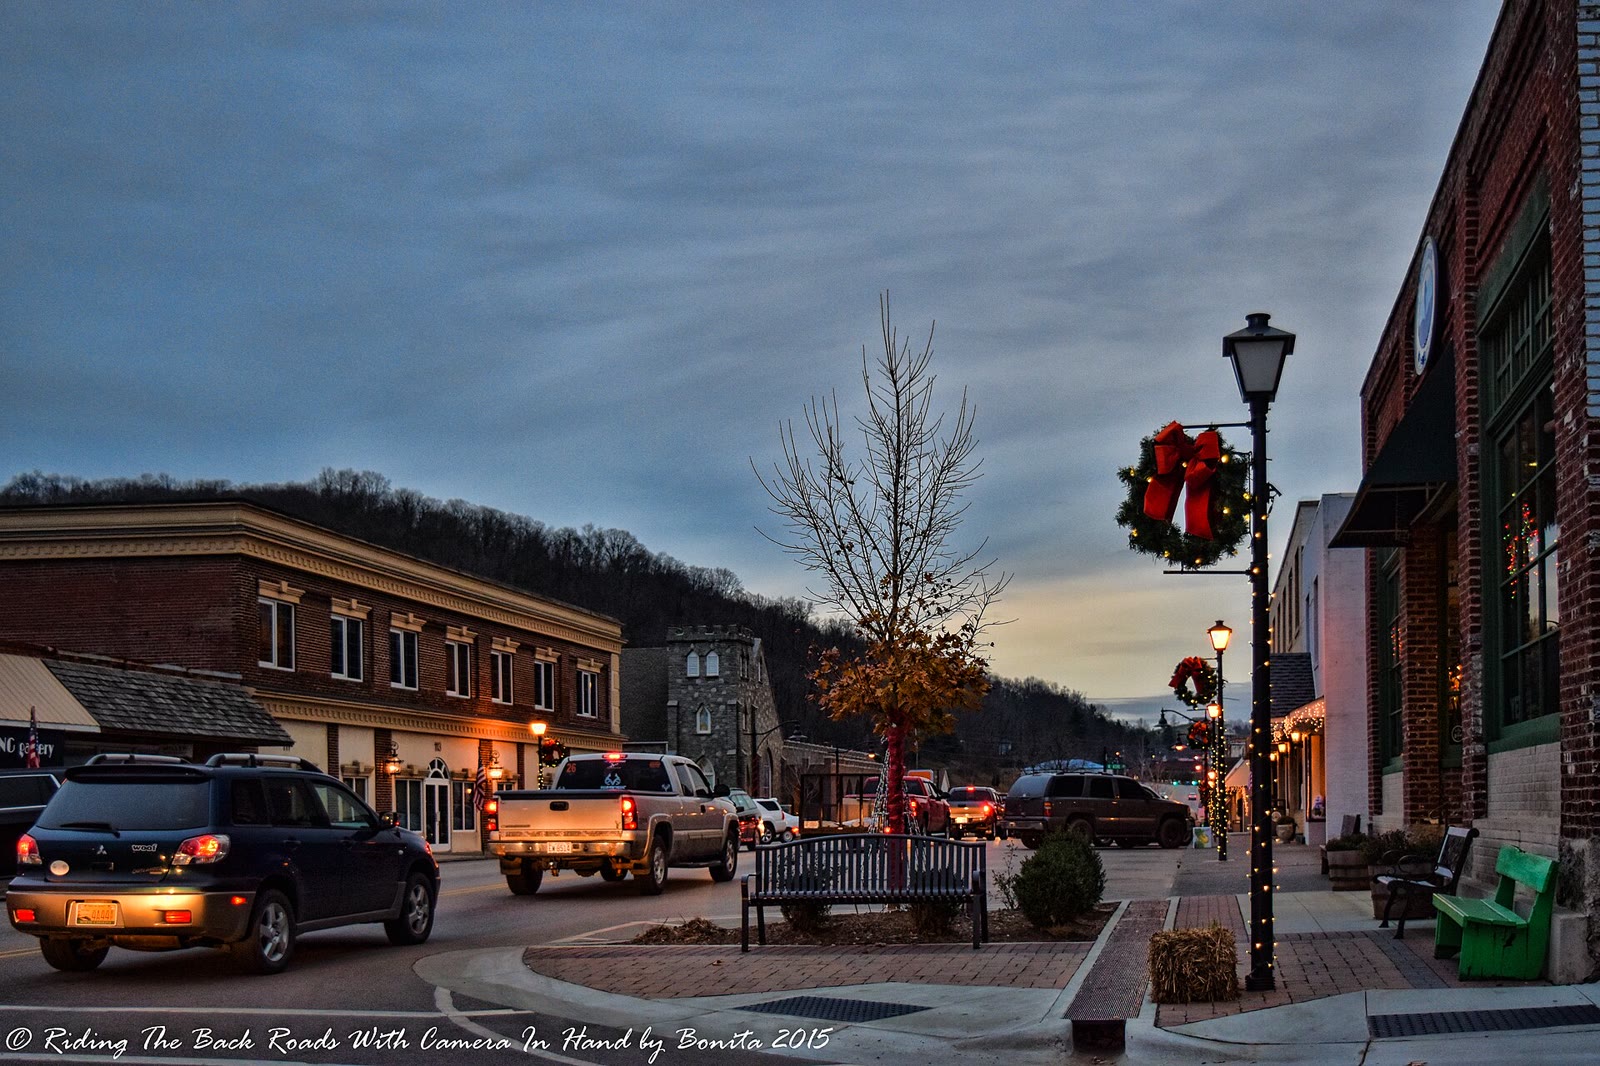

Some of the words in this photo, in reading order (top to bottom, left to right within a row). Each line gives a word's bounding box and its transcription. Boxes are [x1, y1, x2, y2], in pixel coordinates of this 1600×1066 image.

[19, 742, 54, 758] gaery
[566, 763, 577, 773] 26
[131, 843, 158, 852] woof
